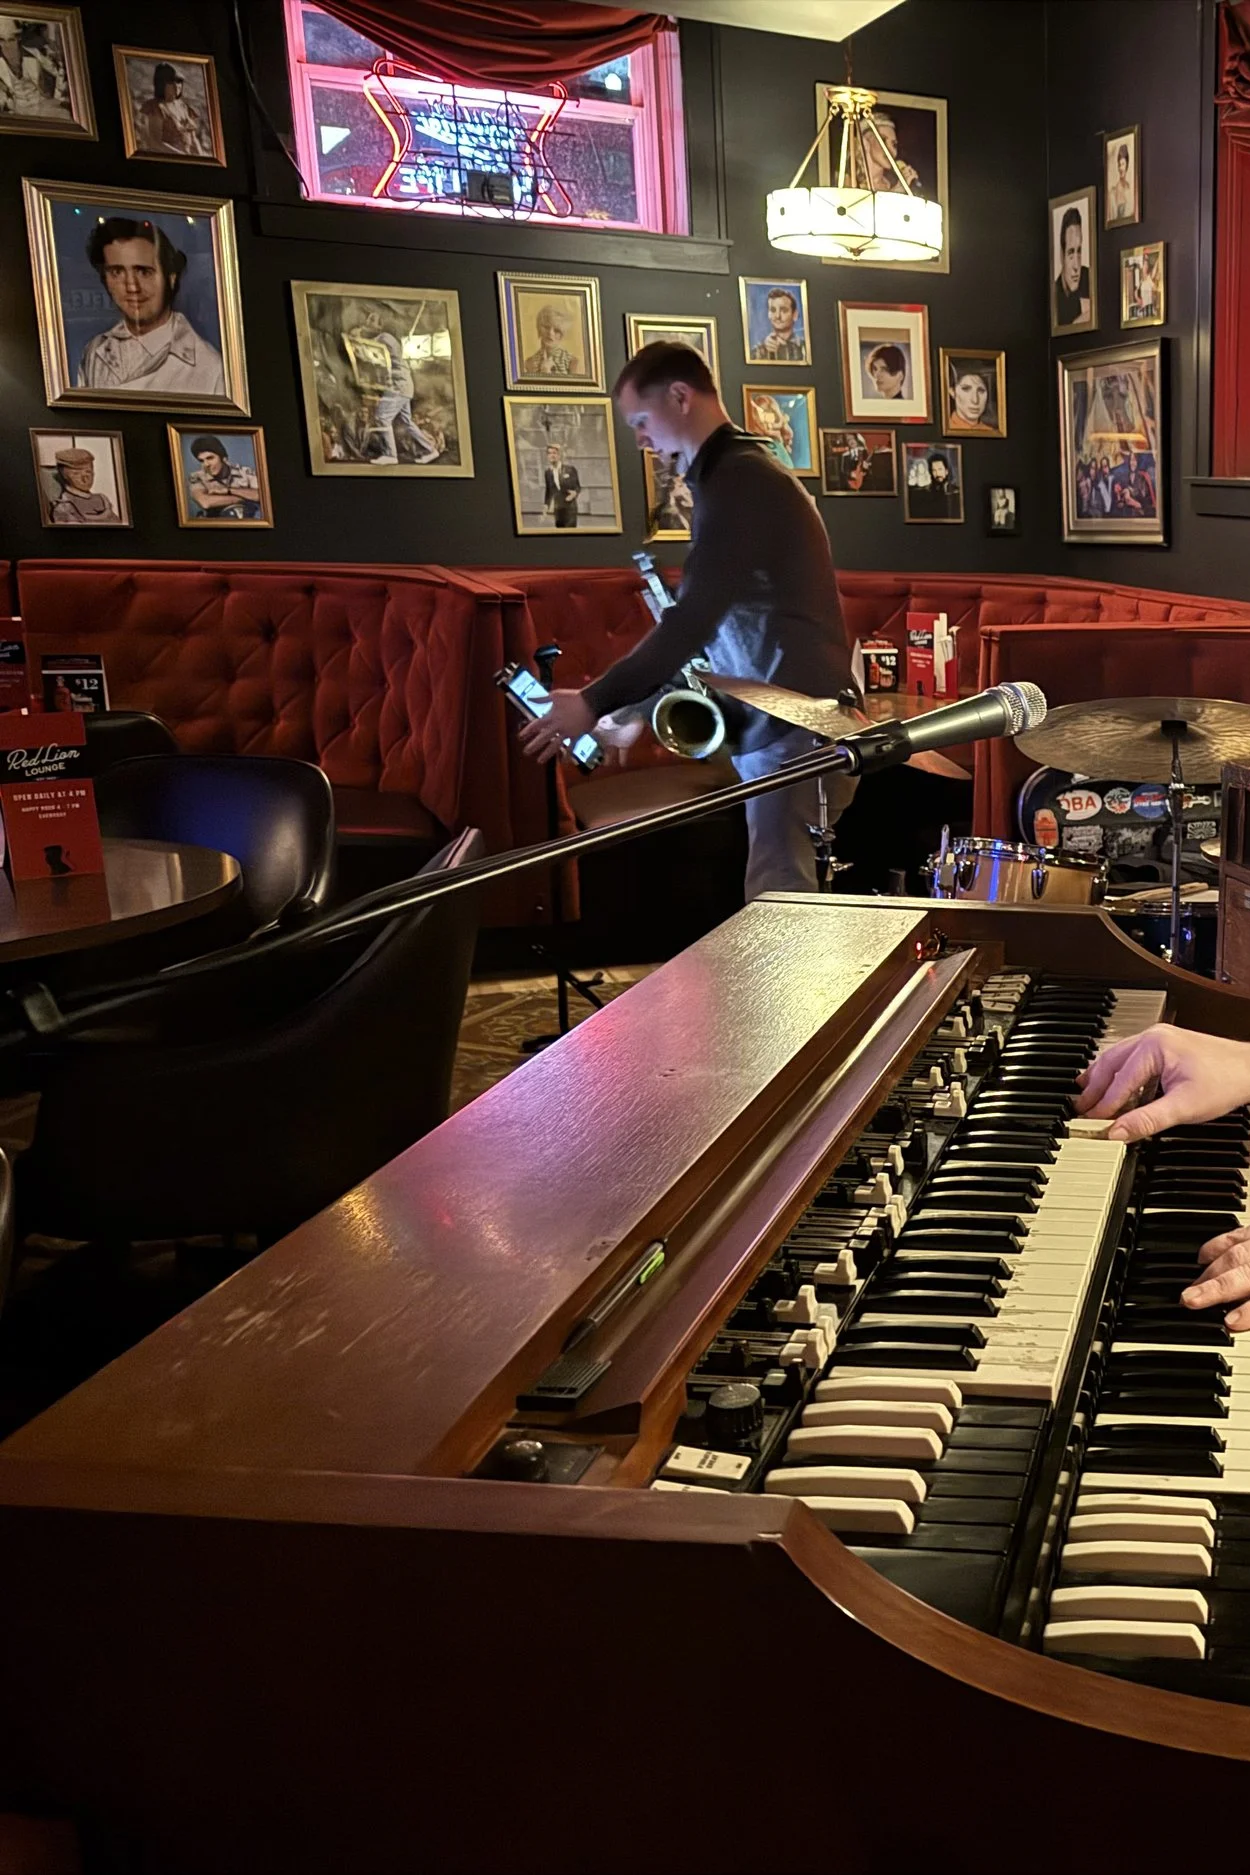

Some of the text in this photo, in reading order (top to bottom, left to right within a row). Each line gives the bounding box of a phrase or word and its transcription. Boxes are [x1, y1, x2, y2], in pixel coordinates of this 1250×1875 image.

[7, 743, 80, 771] Red Lion
[25, 762, 65, 776] LOUNGE
